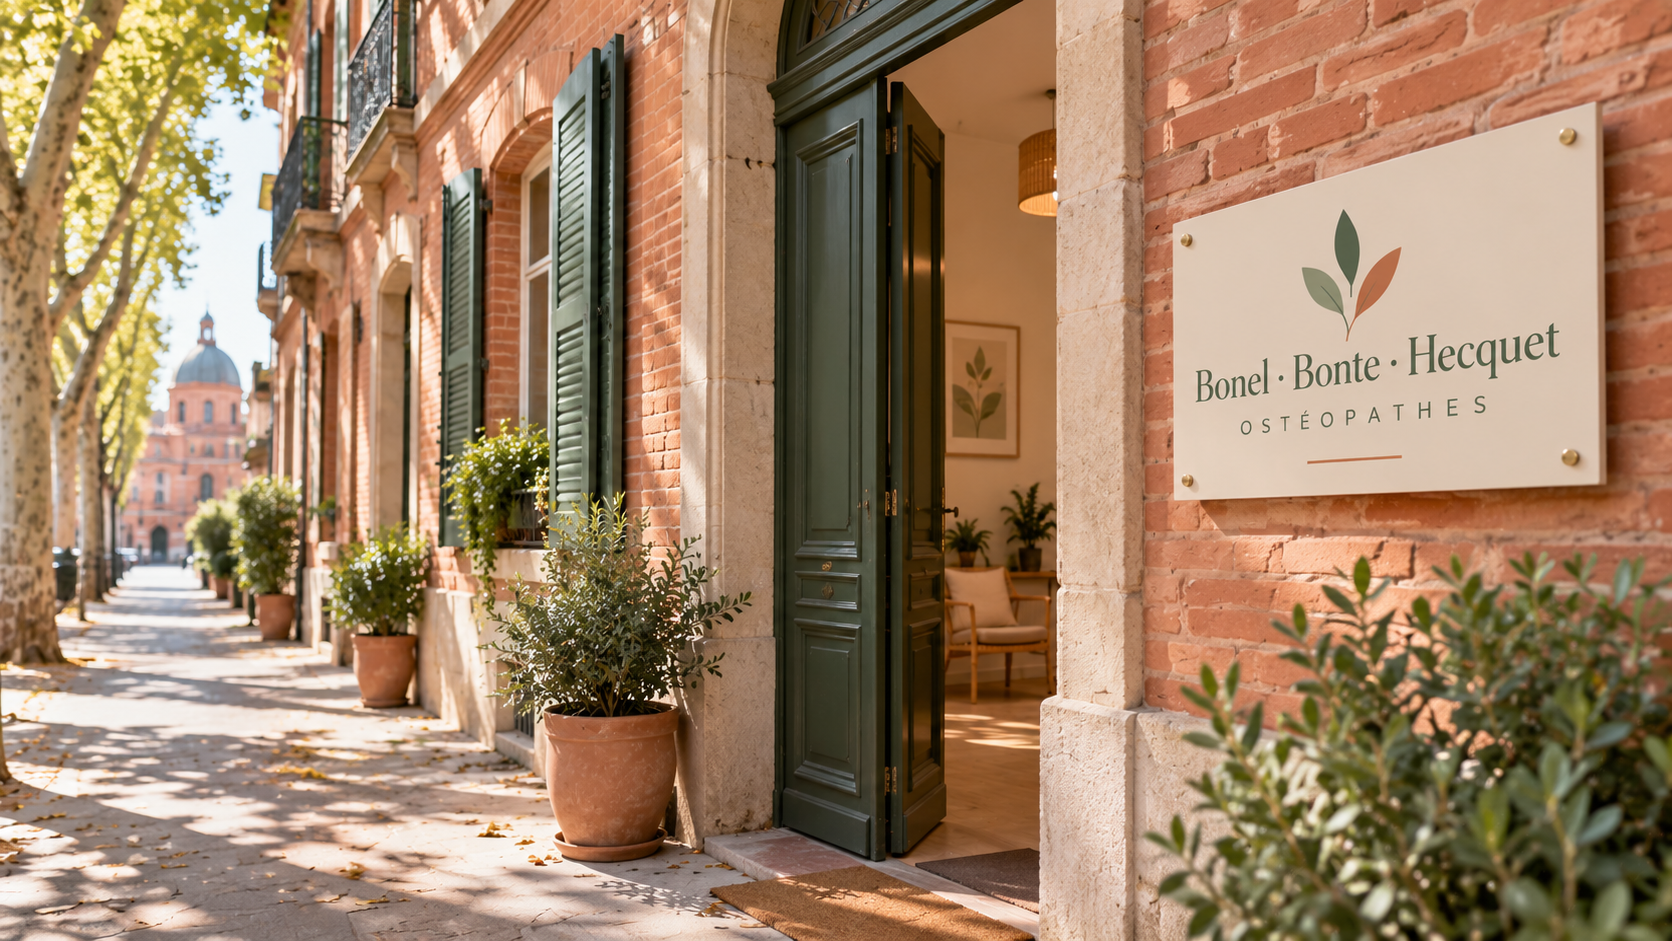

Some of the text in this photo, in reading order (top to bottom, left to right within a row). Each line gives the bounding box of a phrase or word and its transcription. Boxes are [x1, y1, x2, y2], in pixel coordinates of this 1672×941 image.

[1195, 322, 1561, 403] Bonel Bonte Hecquet
[1240, 395, 1487, 436] OSTÉOPATHES
